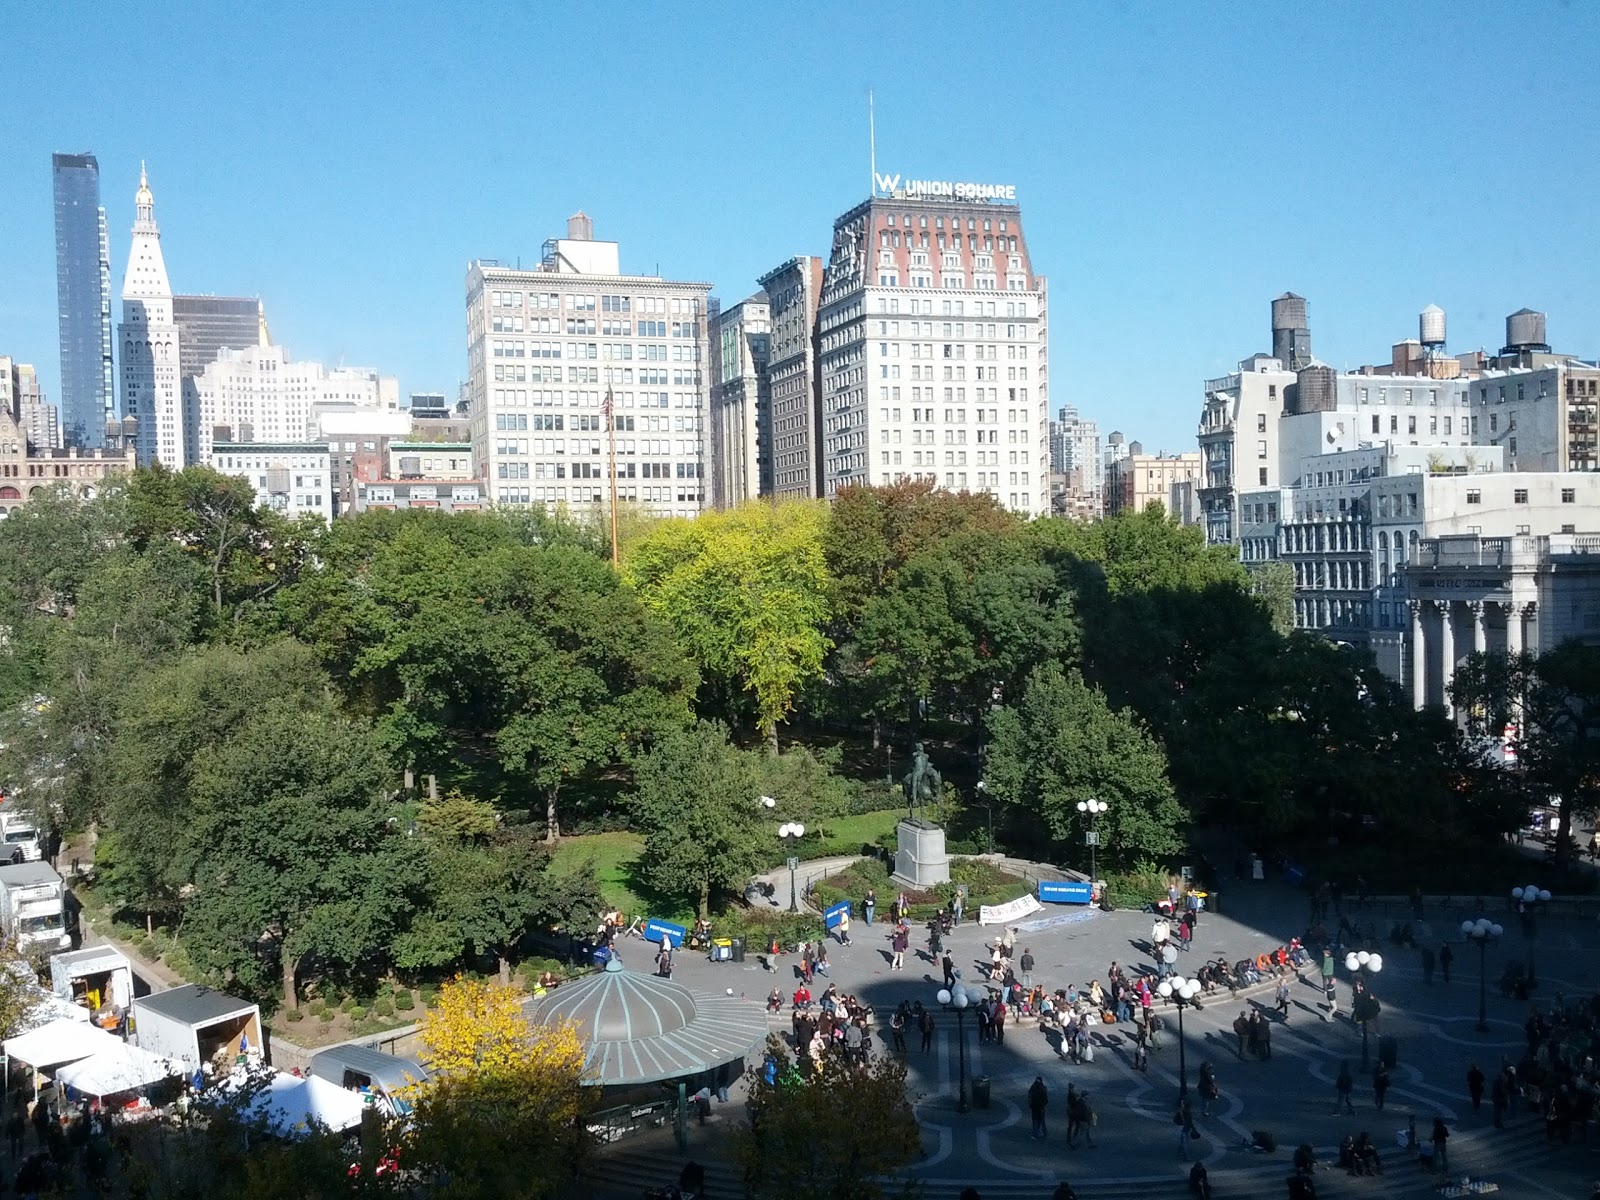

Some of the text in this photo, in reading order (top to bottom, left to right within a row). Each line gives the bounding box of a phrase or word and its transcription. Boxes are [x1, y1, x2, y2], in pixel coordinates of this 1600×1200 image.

[875, 172, 1015, 199] W UNION SQUARE
[631, 1107, 652, 1117] Subway
